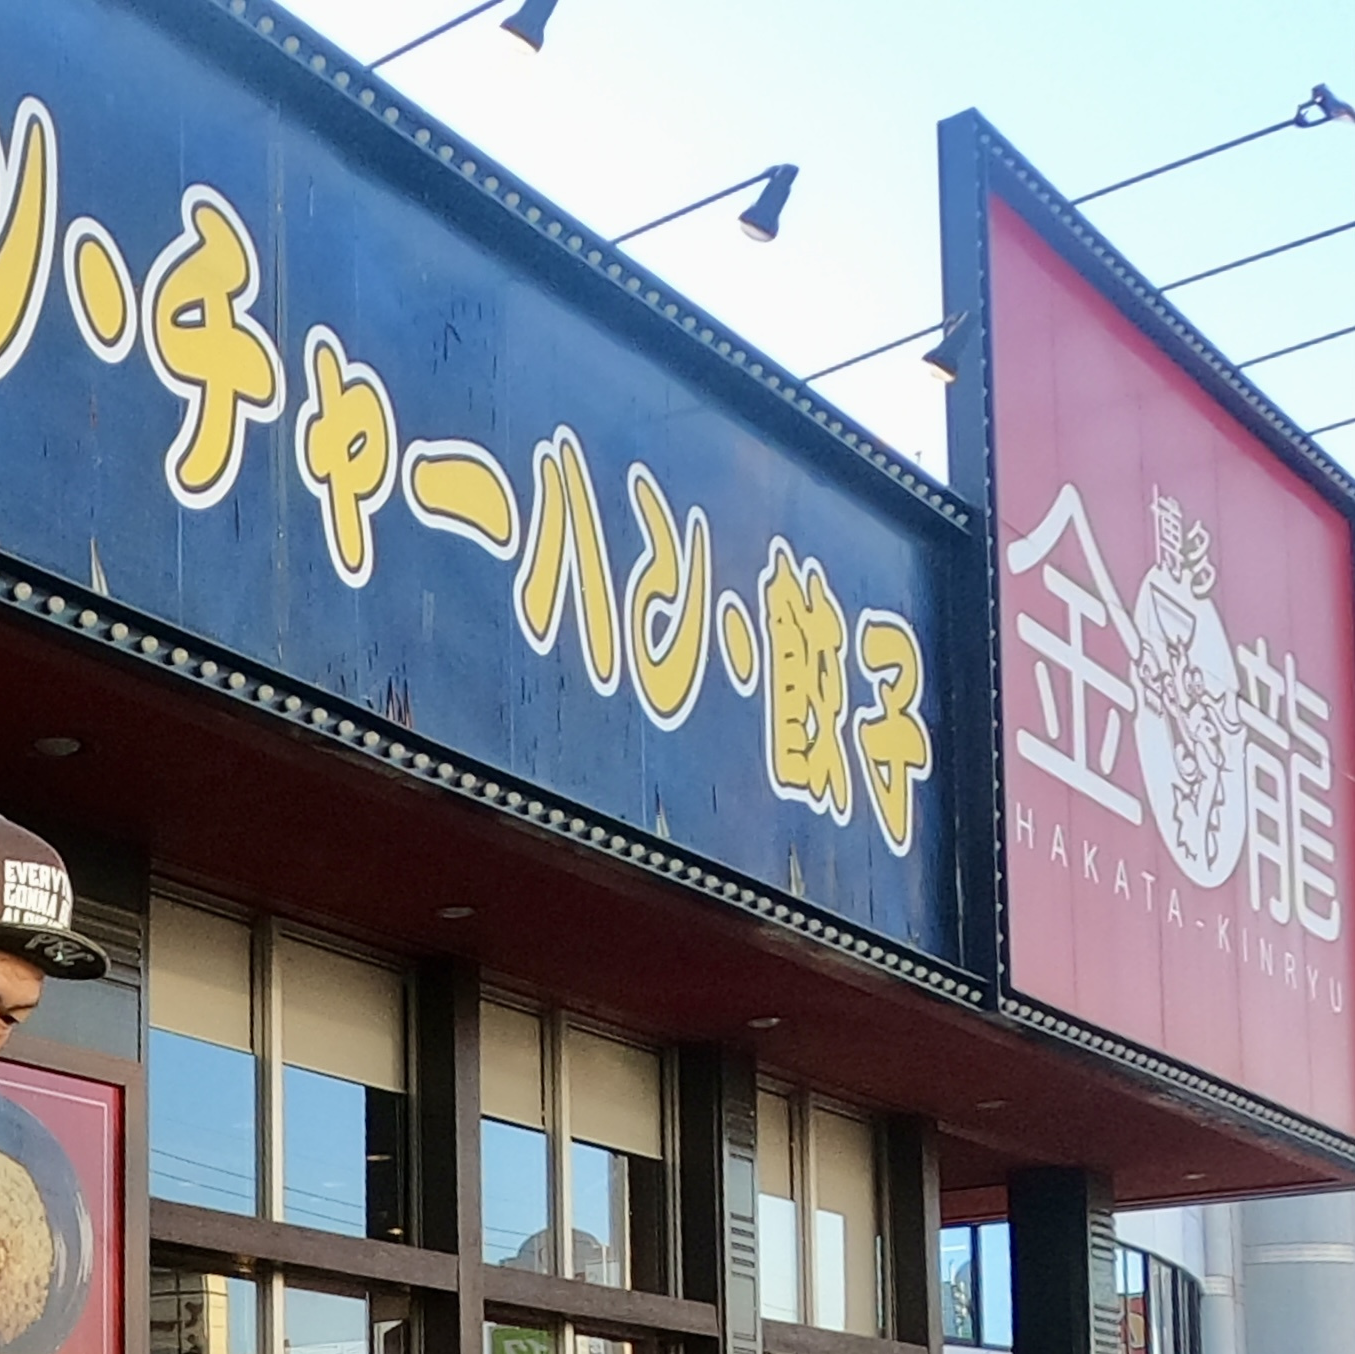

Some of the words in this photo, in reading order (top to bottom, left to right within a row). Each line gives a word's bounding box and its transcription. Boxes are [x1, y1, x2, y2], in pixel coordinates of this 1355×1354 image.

[1151, 482, 1218, 598] 博多
[1007, 482, 1341, 943] 金龍
[1014, 801, 1343, 1015] HAKATA-KINRYU
